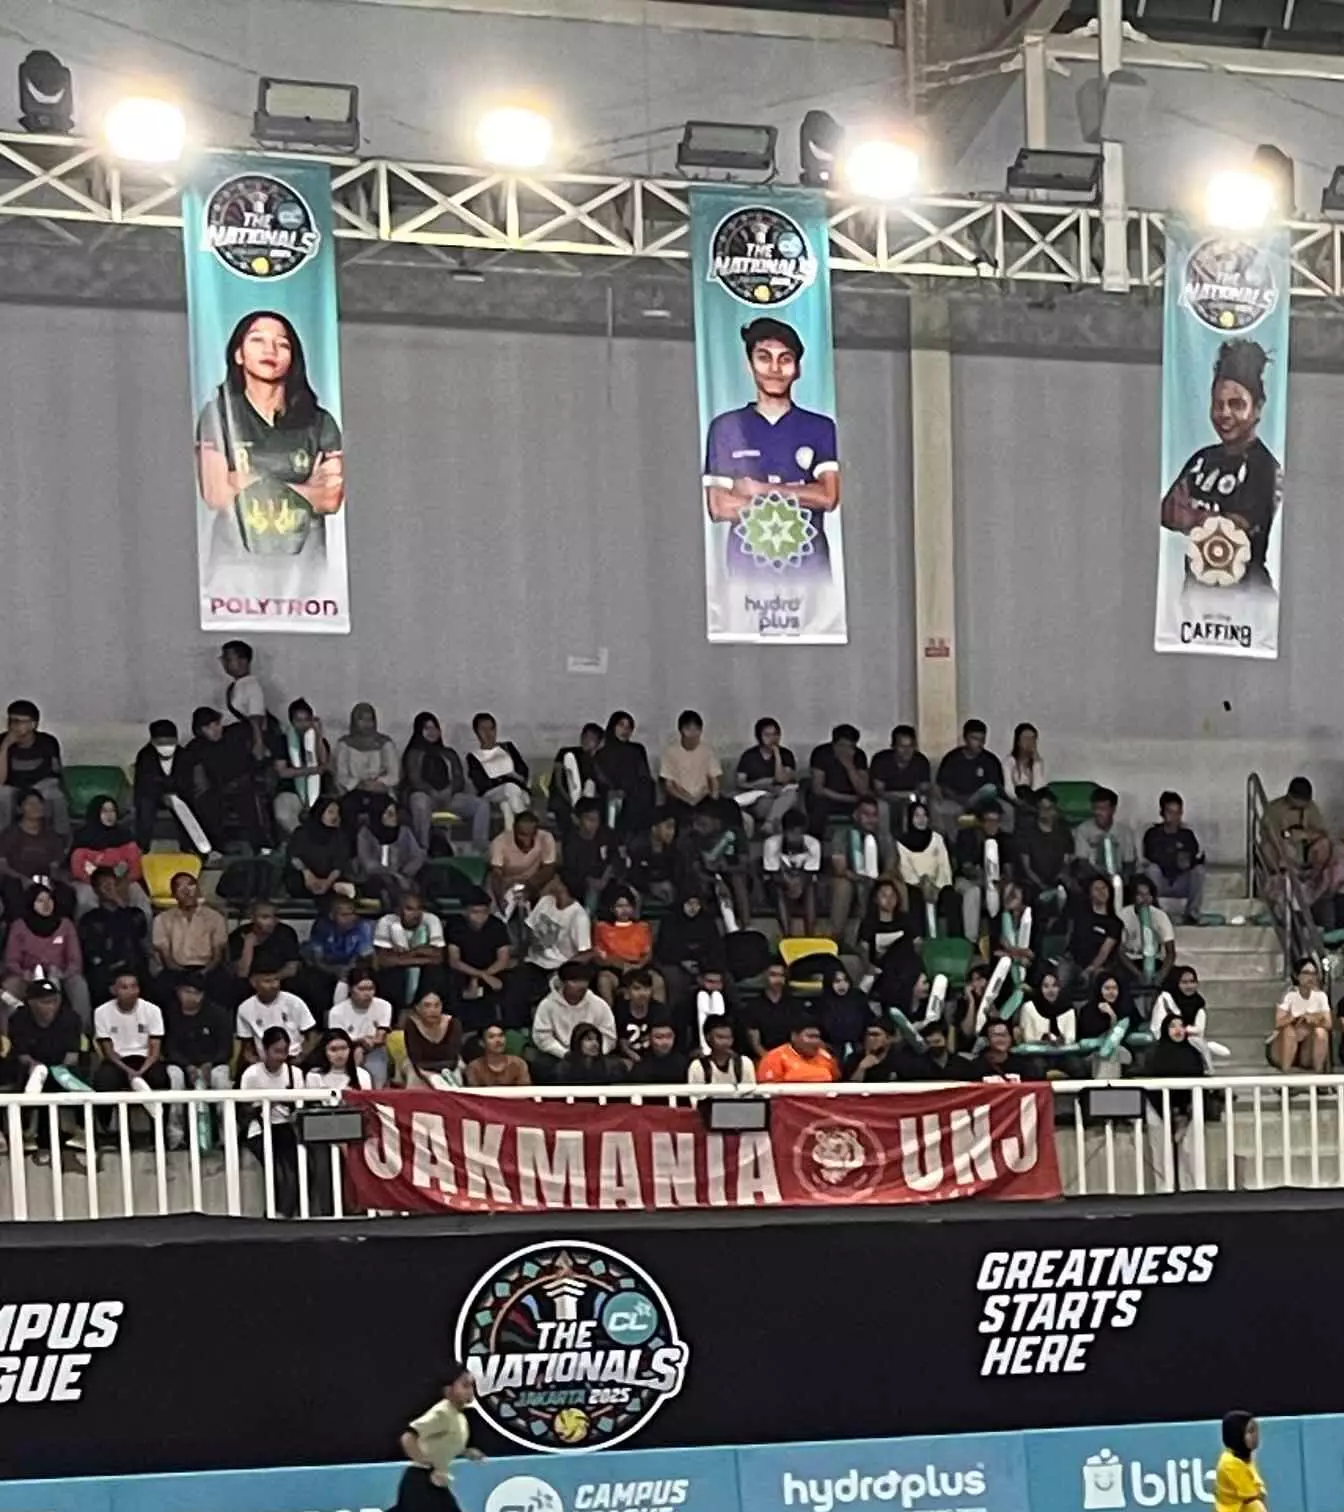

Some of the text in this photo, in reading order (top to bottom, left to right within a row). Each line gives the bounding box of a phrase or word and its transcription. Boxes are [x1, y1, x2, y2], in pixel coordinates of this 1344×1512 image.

[210, 597, 338, 616] POLYTRON
[364, 1092, 1038, 1208] JAKMANIA UNJ
[976, 1244, 1219, 1291] GREATNESS
[978, 1289, 1142, 1333] STARTS
[537, 1320, 597, 1350] THE
[980, 1333, 1096, 1376] HERE
[466, 1348, 682, 1398] NATIONALS
[588, 1387, 632, 1405] 2025
[574, 1478, 690, 1510] CAMPUS
[783, 1464, 986, 1512] hydroplus
[1130, 1458, 1217, 1507] blib
